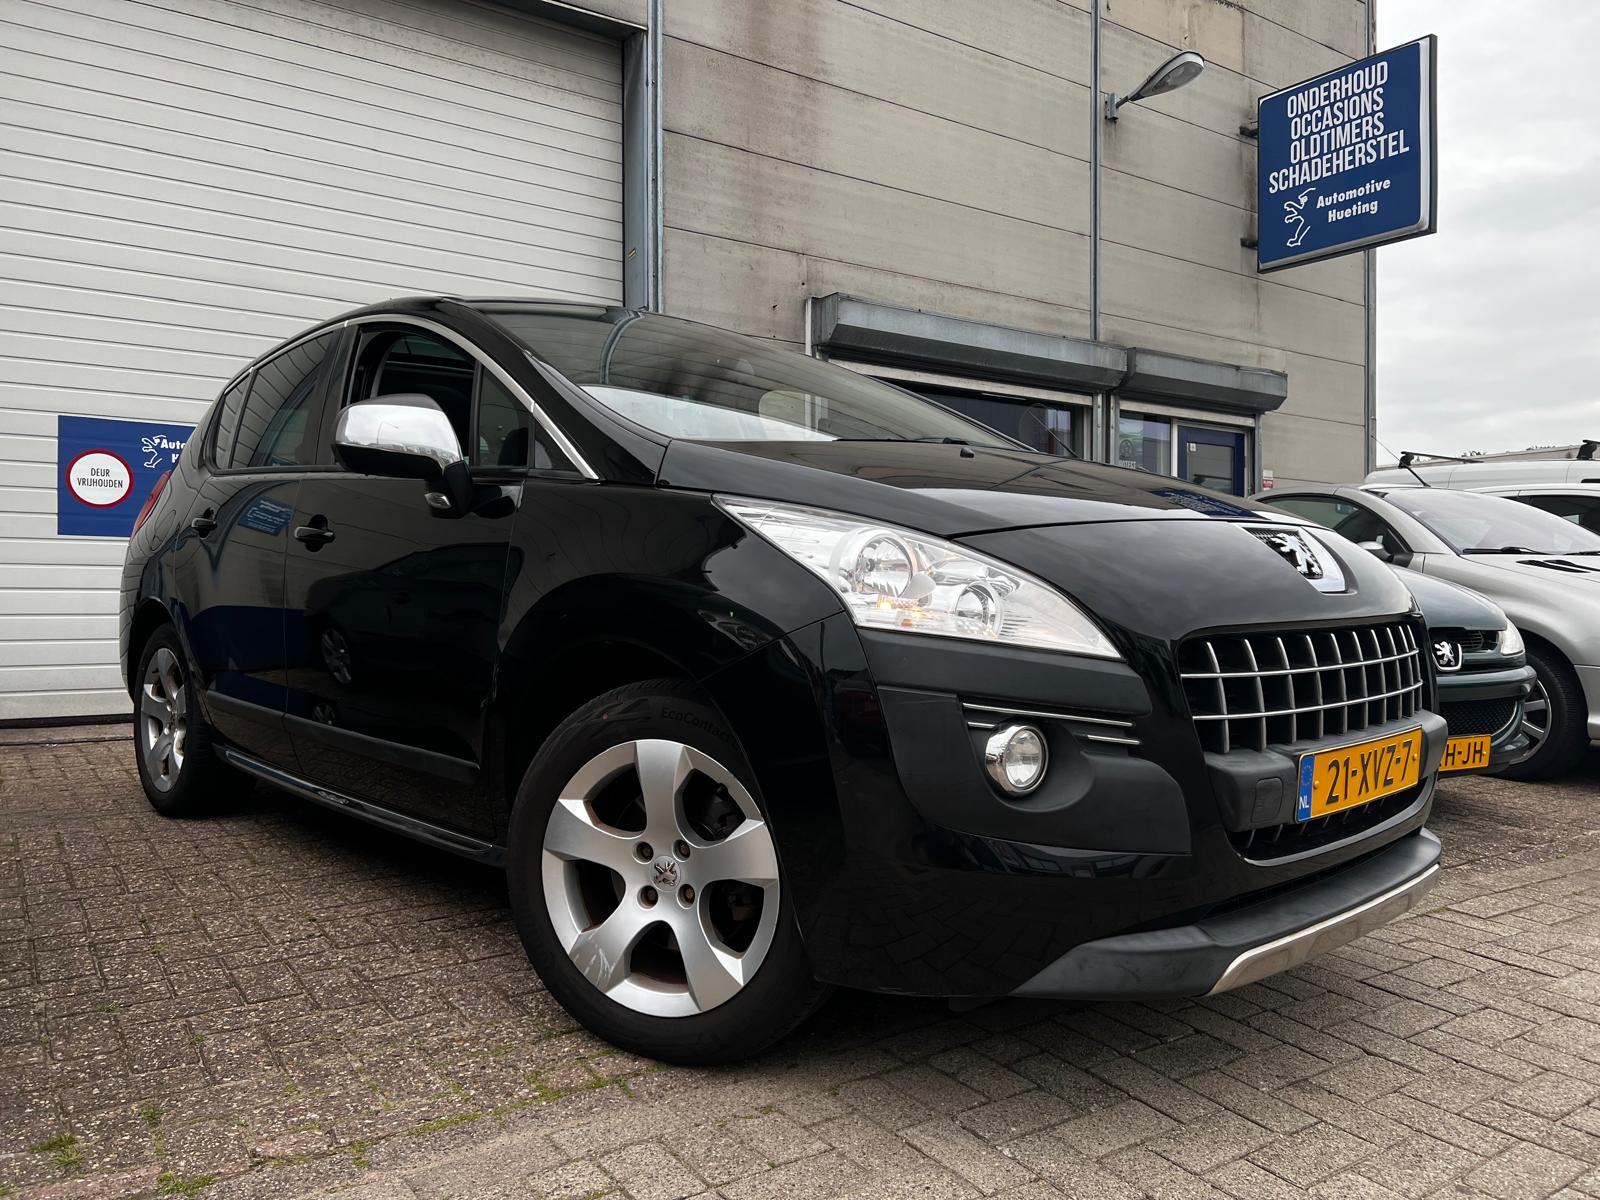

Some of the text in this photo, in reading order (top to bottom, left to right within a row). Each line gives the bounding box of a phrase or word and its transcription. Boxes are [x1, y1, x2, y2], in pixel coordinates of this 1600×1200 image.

[1287, 61, 1388, 118] ONDERHOUD
[1291, 88, 1384, 140] OCCASIONS
[1290, 112, 1385, 164] OLDTIMERS
[1269, 129, 1410, 194] SCHADEHERSTEL
[1316, 179, 1391, 209] Automotive
[1328, 200, 1378, 223] Hueting
[77, 477, 123, 488] VRIJHOUDEN
[90, 468, 110, 477] DEUR
[1439, 741, 1484, 767] H-JH
[1326, 739, 1413, 806] 21-XVZ-7
[1299, 796, 1310, 809] NL
